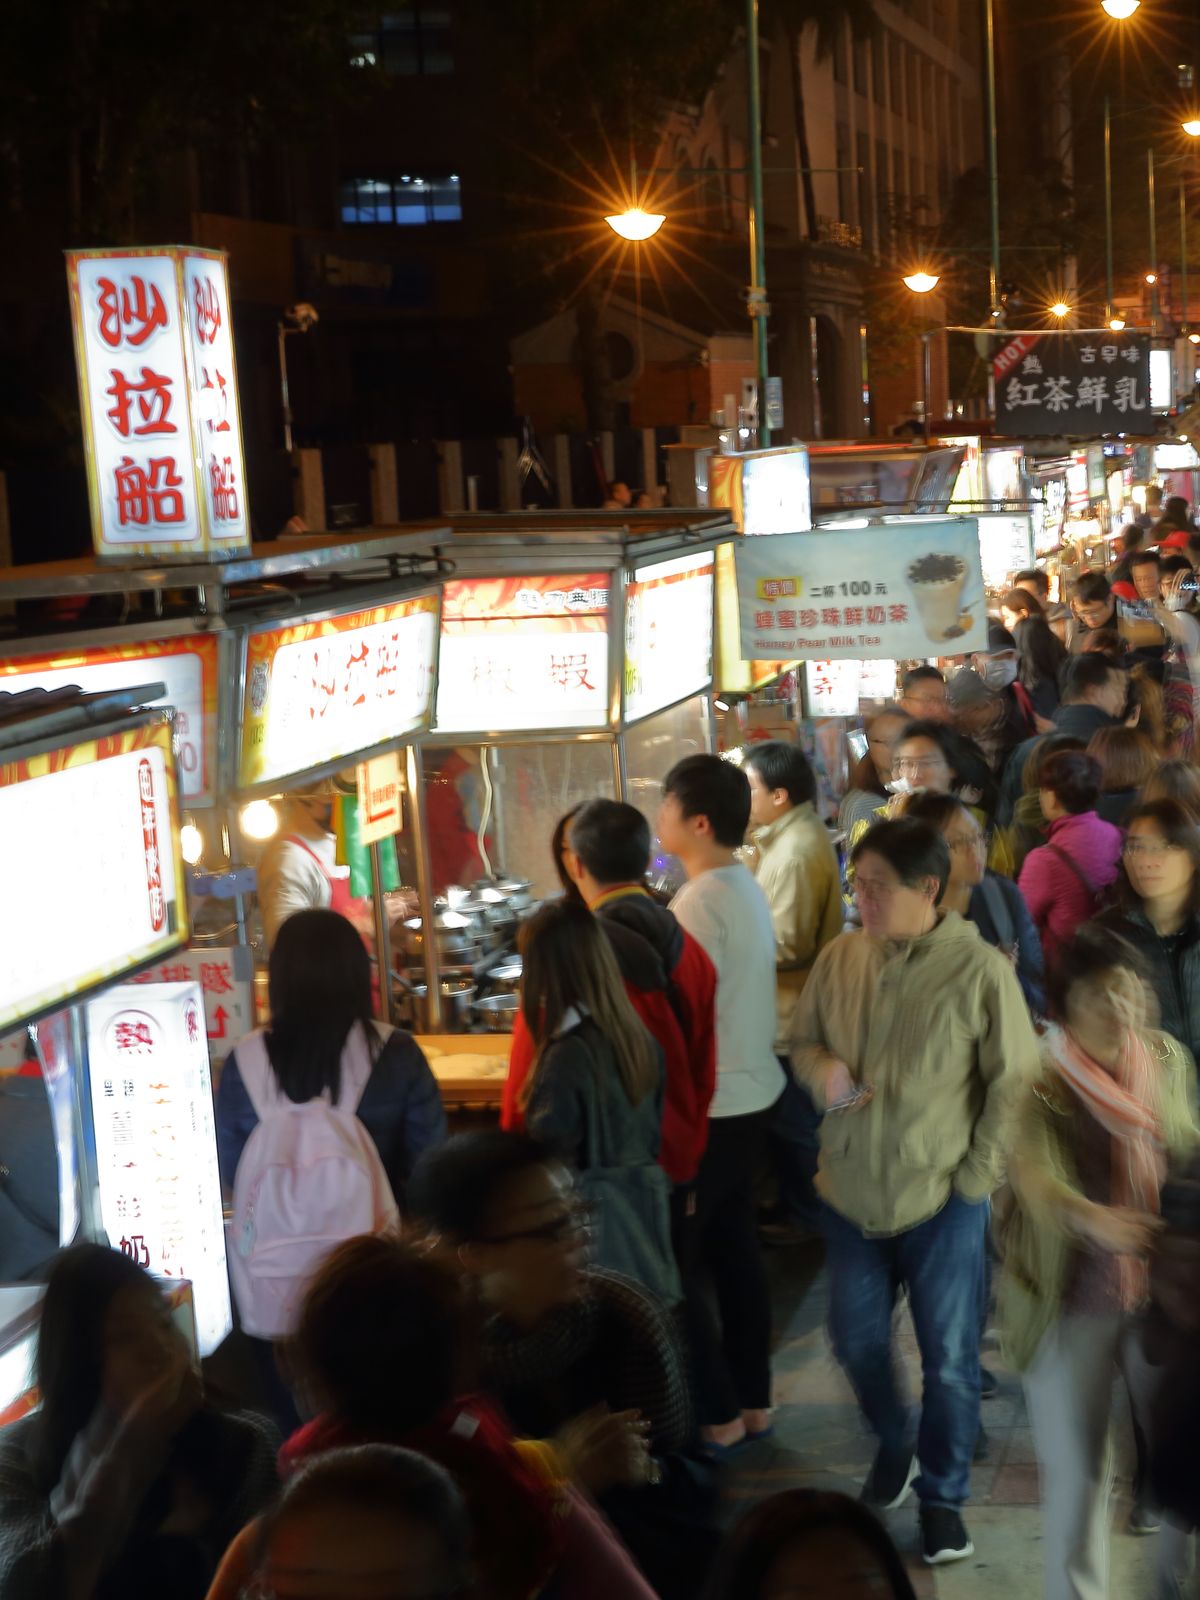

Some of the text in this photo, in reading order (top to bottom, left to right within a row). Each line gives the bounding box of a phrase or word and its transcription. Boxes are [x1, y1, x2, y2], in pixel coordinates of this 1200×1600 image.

[994, 337, 1027, 370] HOT
[1079, 345, 1142, 364] 古早味
[96, 275, 187, 527] 沙拉船
[1005, 375, 1147, 414] 紅茶鮮乳
[839, 580, 872, 597] 100
[875, 582, 888, 595] 元
[829, 635, 855, 648] Milk
